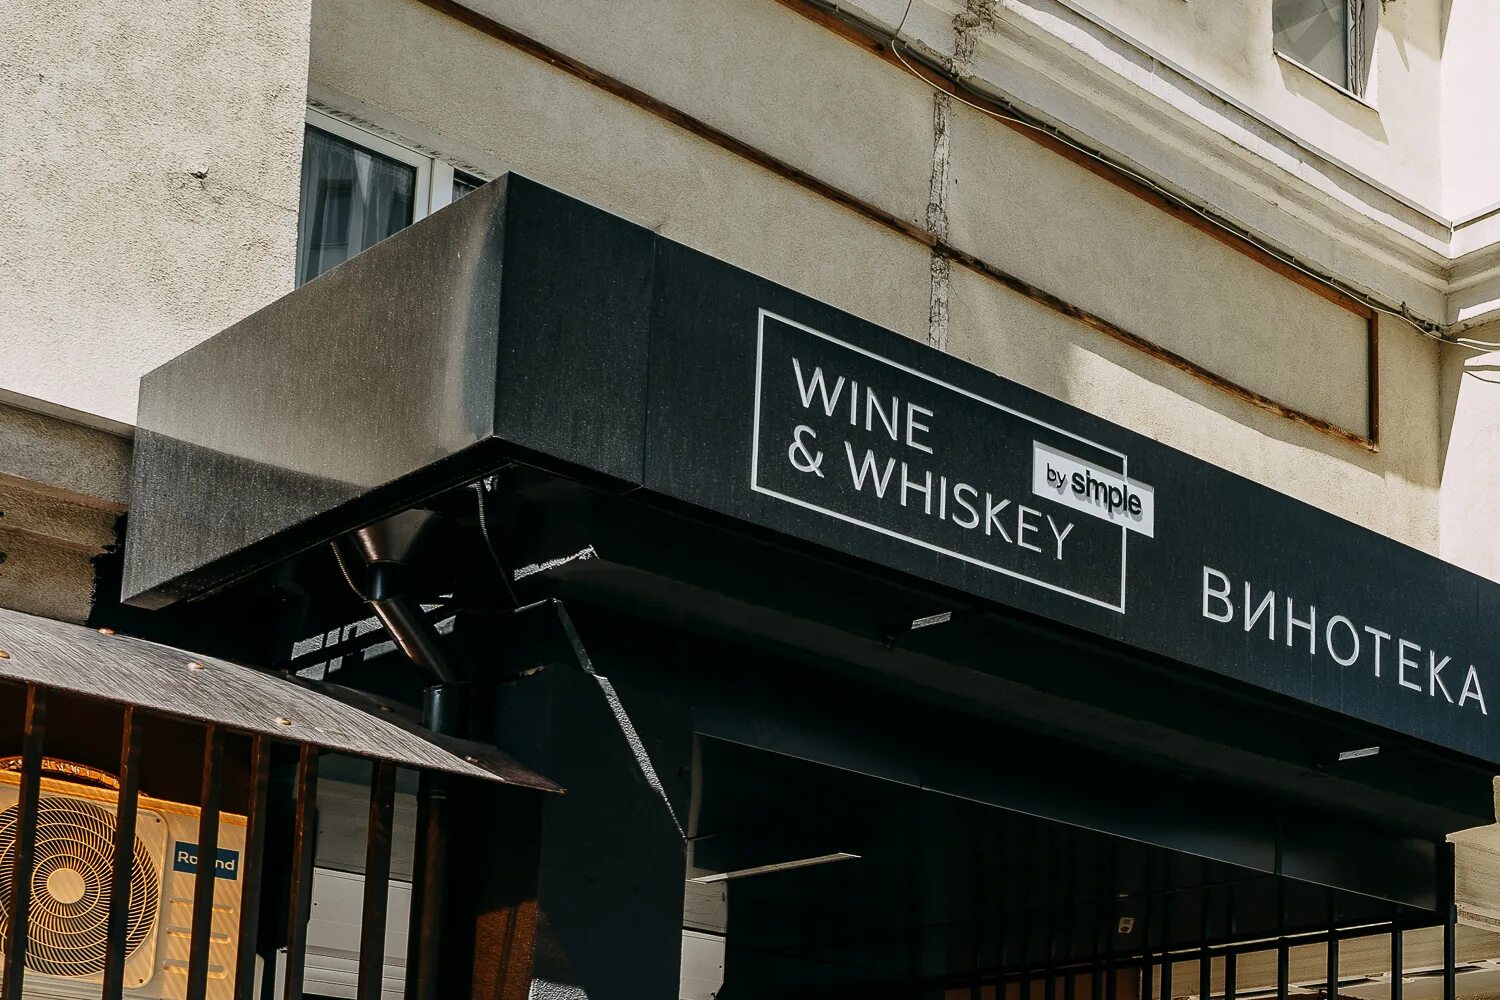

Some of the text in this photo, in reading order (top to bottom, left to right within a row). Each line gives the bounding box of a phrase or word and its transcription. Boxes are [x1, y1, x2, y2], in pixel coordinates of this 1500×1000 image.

[792, 356, 935, 455] WINE
[788, 425, 1076, 561] & WHISKEY
[1046, 463, 1145, 517] by simple
[1202, 565, 1489, 717] ВИНОТЕКА
[177, 850, 236, 871] Rond
